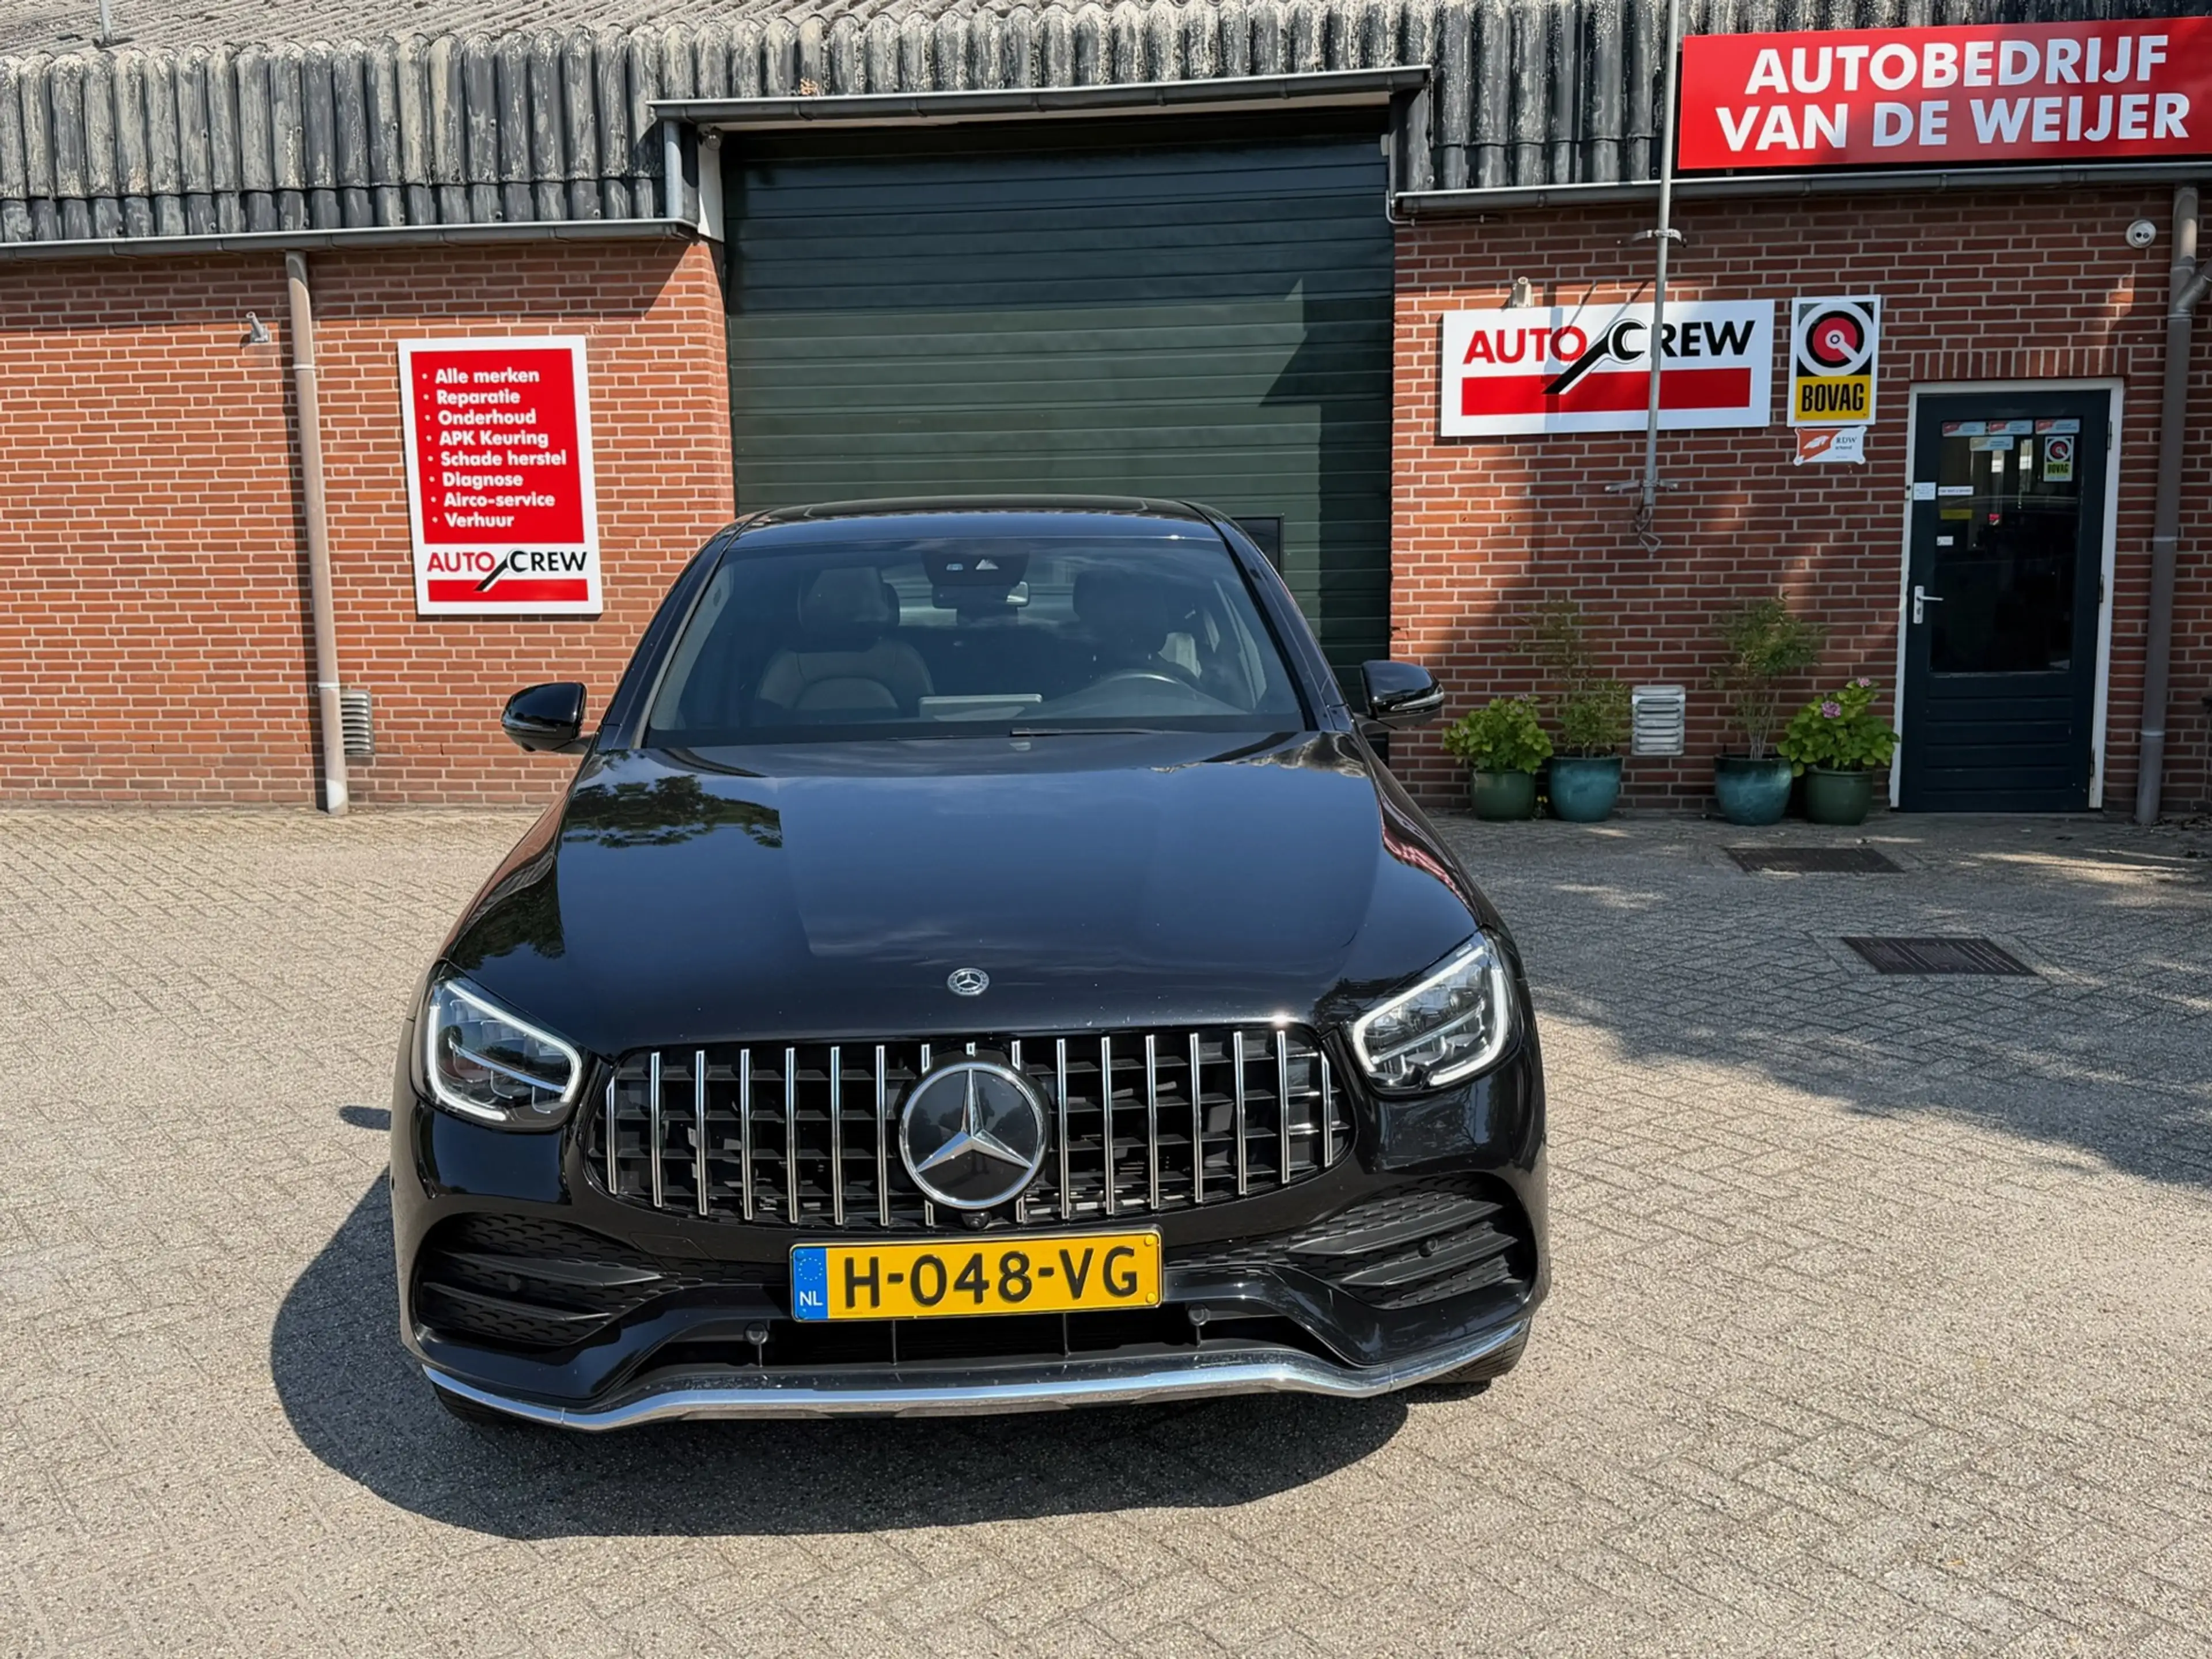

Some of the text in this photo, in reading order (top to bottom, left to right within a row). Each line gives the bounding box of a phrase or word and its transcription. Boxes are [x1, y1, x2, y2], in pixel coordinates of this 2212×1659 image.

[1744, 35, 2169, 95] AUTOBEDRIJF
[1715, 93, 2190, 152] VAN DE WEIJER
[1463, 320, 1756, 365] AUTO CREW
[435, 368, 540, 384] Alle merken
[437, 389, 520, 408] Reparatie
[1801, 382, 1864, 412] BOVAG
[438, 409, 536, 425] Onderhoud
[439, 430, 549, 449] APK Keuring
[441, 450, 567, 467] Schade herstel
[442, 472, 524, 491] Diagnose
[444, 491, 555, 507] Airco-service
[444, 512, 514, 528] Verhuur
[427, 551, 588, 573] AUTO CREW
[844, 1245, 1138, 1308] H-048-VG
[799, 1290, 824, 1306] NL
